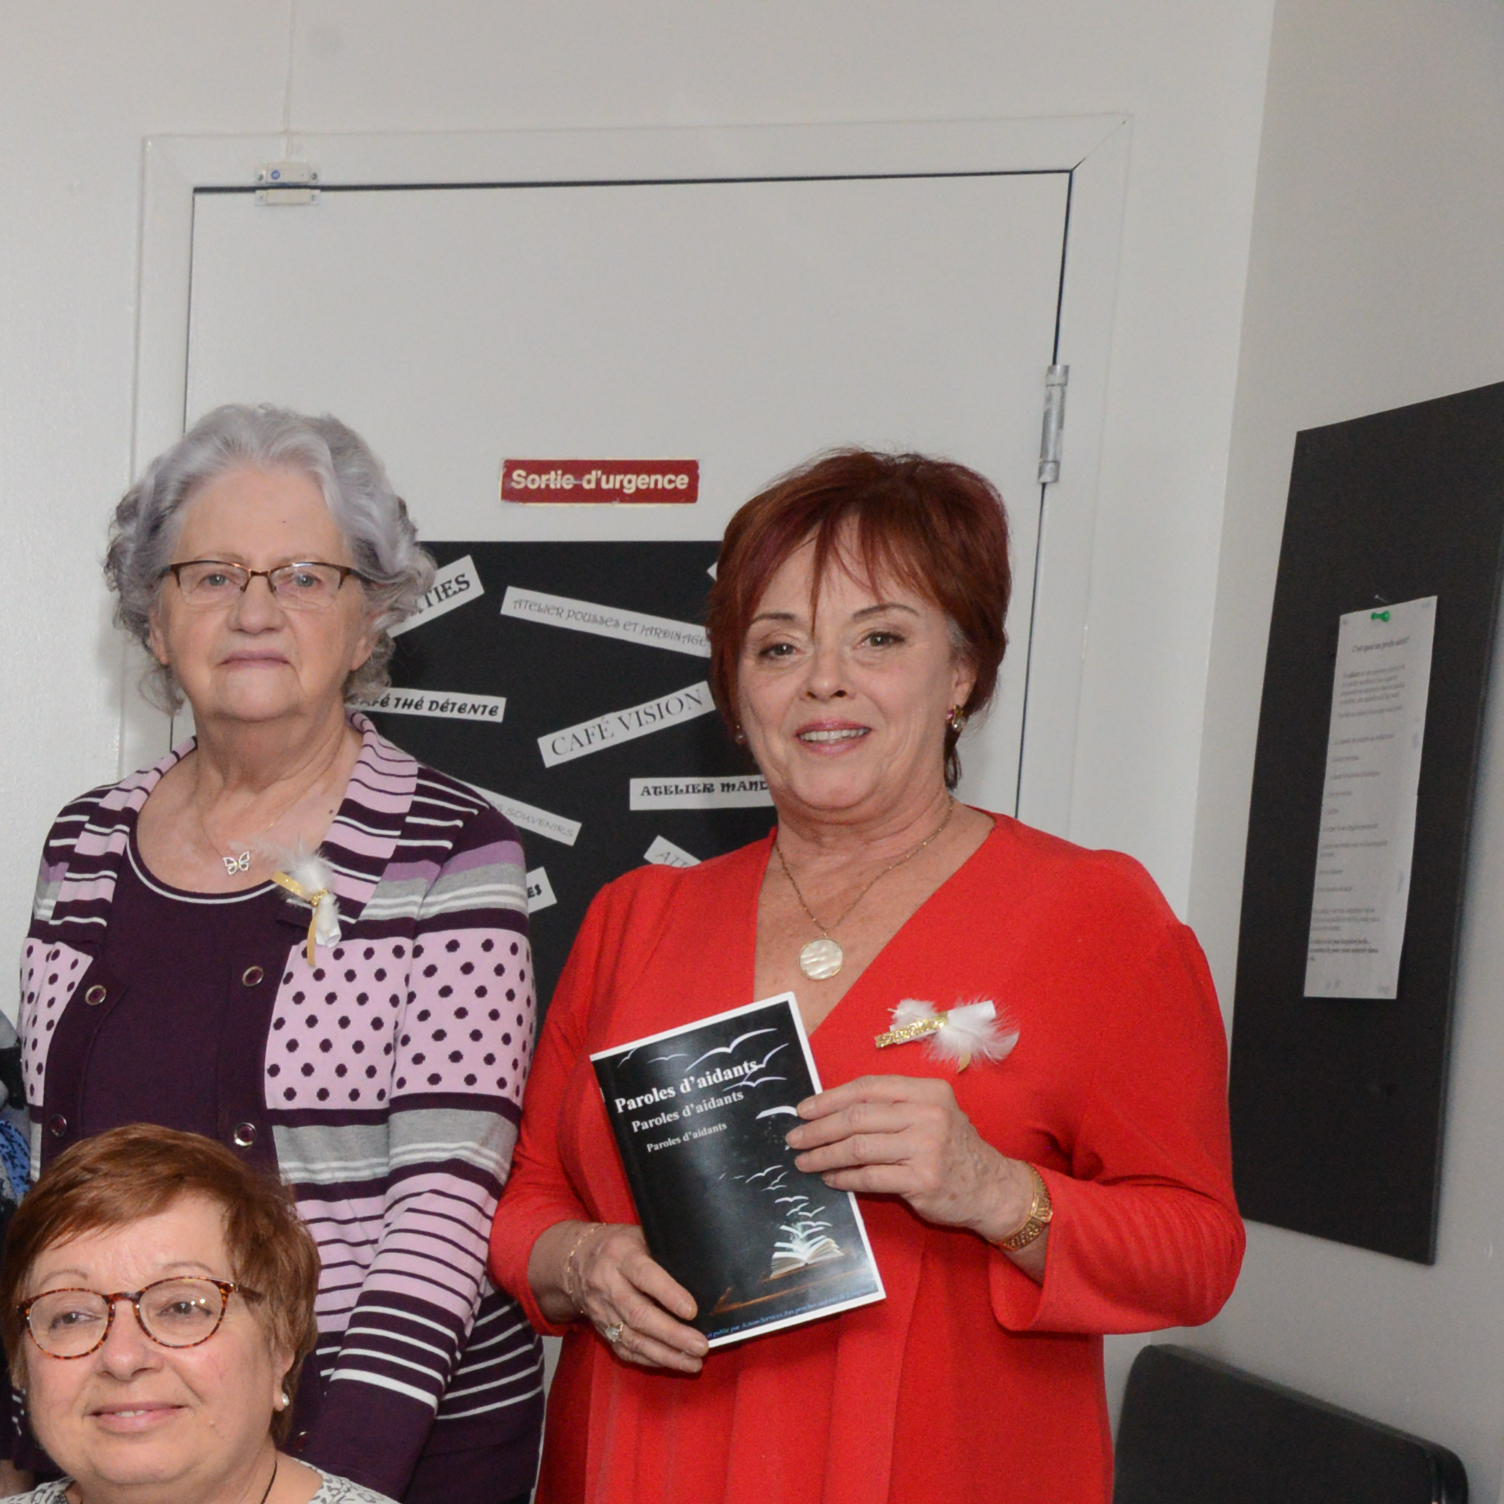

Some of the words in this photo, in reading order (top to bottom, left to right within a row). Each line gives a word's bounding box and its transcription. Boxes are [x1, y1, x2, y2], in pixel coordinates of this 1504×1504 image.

[511, 469, 575, 490] Sortie
[582, 470, 689, 493] d'urgence
[418, 573, 471, 614] TIES
[513, 598, 564, 618] ATELIER
[623, 620, 637, 633] ET
[394, 695, 425, 711] THÉ
[428, 698, 499, 717] DÉTENTE
[550, 717, 615, 756] CAFÉ
[617, 689, 704, 732] VISION
[640, 782, 715, 797] ATELIER
[614, 1085, 677, 1114] Paroles
[679, 1060, 759, 1094] d'aidants
[631, 1110, 680, 1133] Paroles
[682, 1090, 745, 1118] d'aidants
[646, 1136, 682, 1153] Paroles
[682, 1122, 728, 1142] d'aidants
